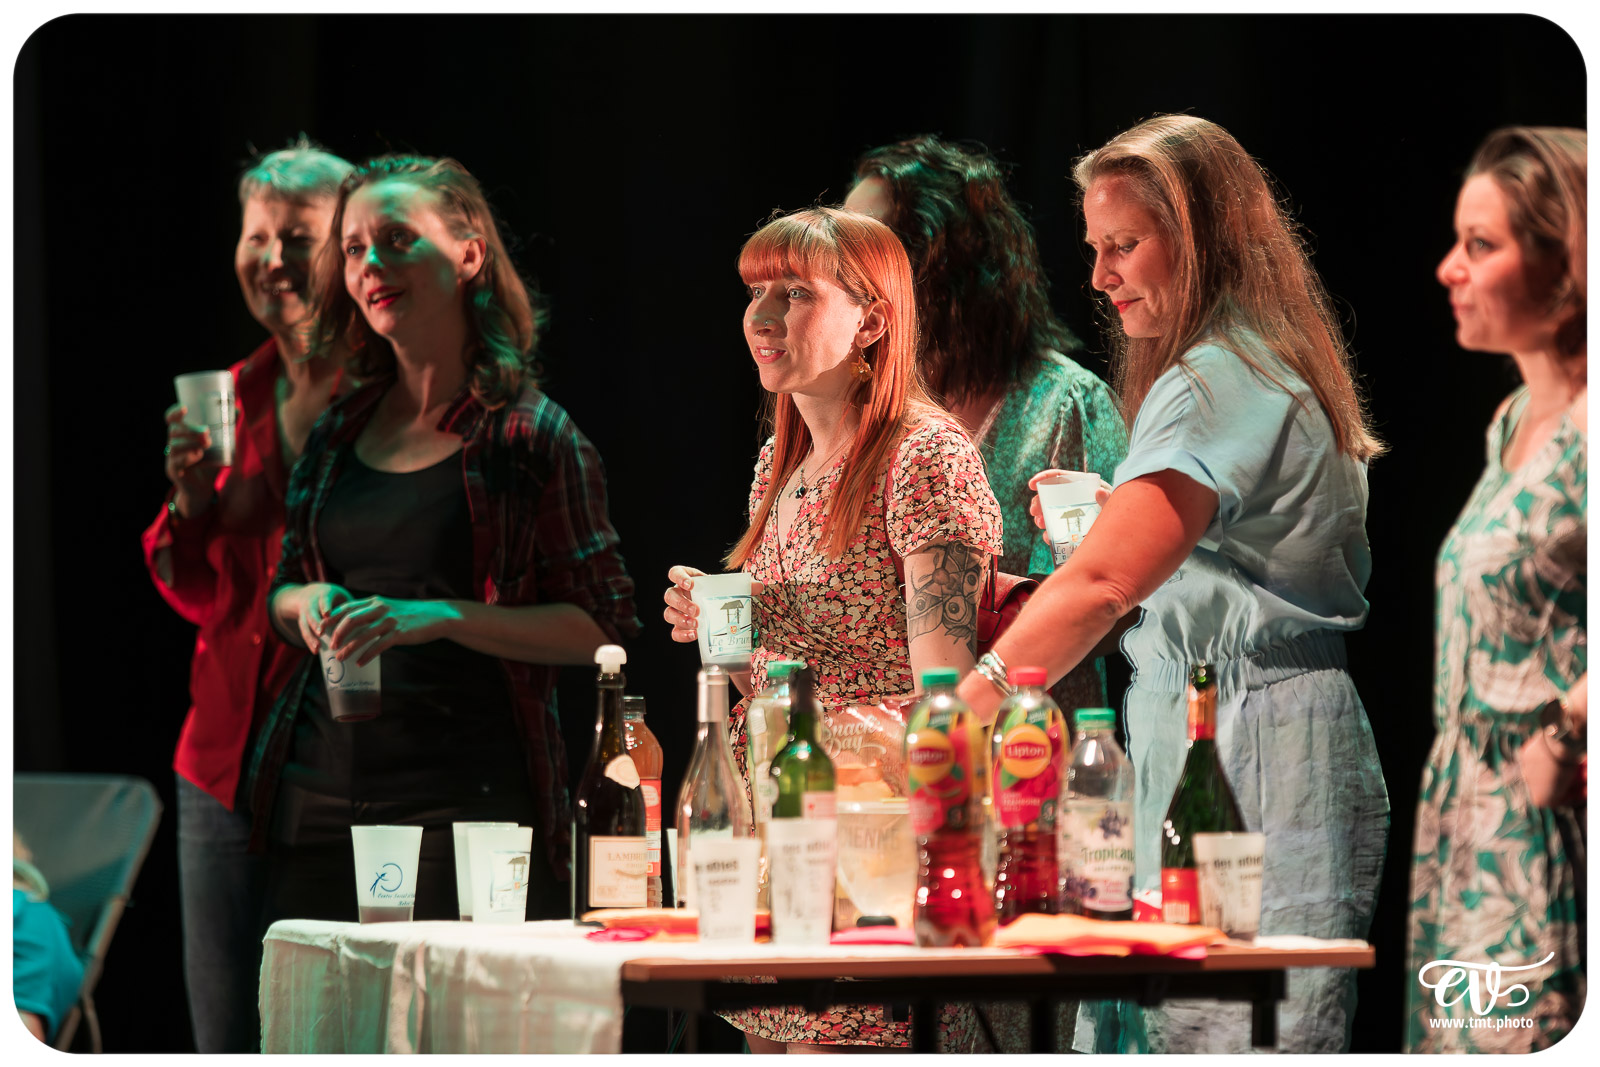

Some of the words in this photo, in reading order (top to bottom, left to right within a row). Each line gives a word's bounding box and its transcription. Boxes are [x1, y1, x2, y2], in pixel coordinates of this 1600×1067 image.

[825, 736, 887, 759] Day
[1007, 746, 1045, 758] Lipton
[911, 750, 946, 761] Lipton
